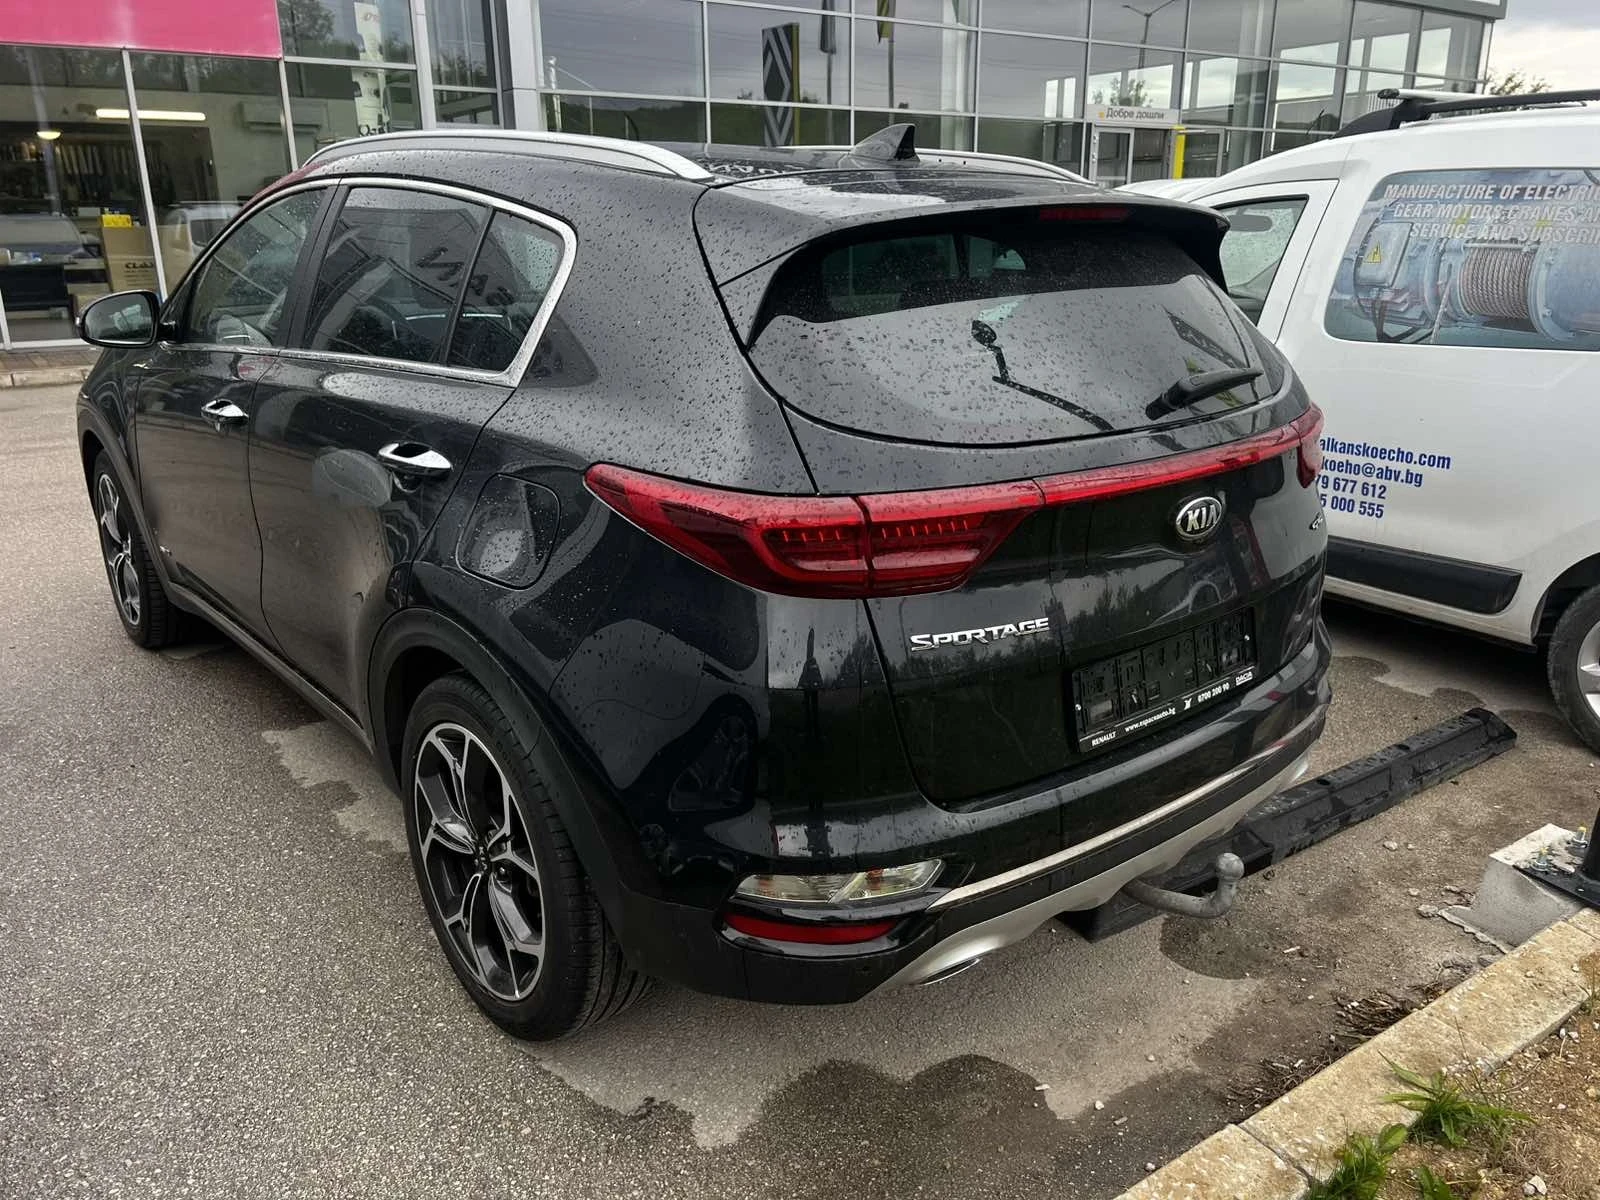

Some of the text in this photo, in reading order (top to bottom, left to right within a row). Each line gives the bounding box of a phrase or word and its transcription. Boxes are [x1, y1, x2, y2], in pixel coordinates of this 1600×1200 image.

[1106, 107, 1165, 120] Добре дошли
[1383, 183, 1497, 200] MANUFACTURE
[1500, 183, 1522, 200] OF
[1393, 203, 1433, 218] GEAR
[1409, 222, 1475, 239] SERVICE
[1478, 224, 1515, 241] AND
[1332, 477, 1358, 494] 677
[1361, 481, 1388, 500] 612
[1184, 503, 1219, 533] KIA
[1330, 495, 1356, 513] 000
[1358, 500, 1385, 519] 555
[909, 617, 1050, 652] SPORTAGE
[1091, 731, 1117, 747] RENAULT
[1235, 671, 1253, 686] DACIA
